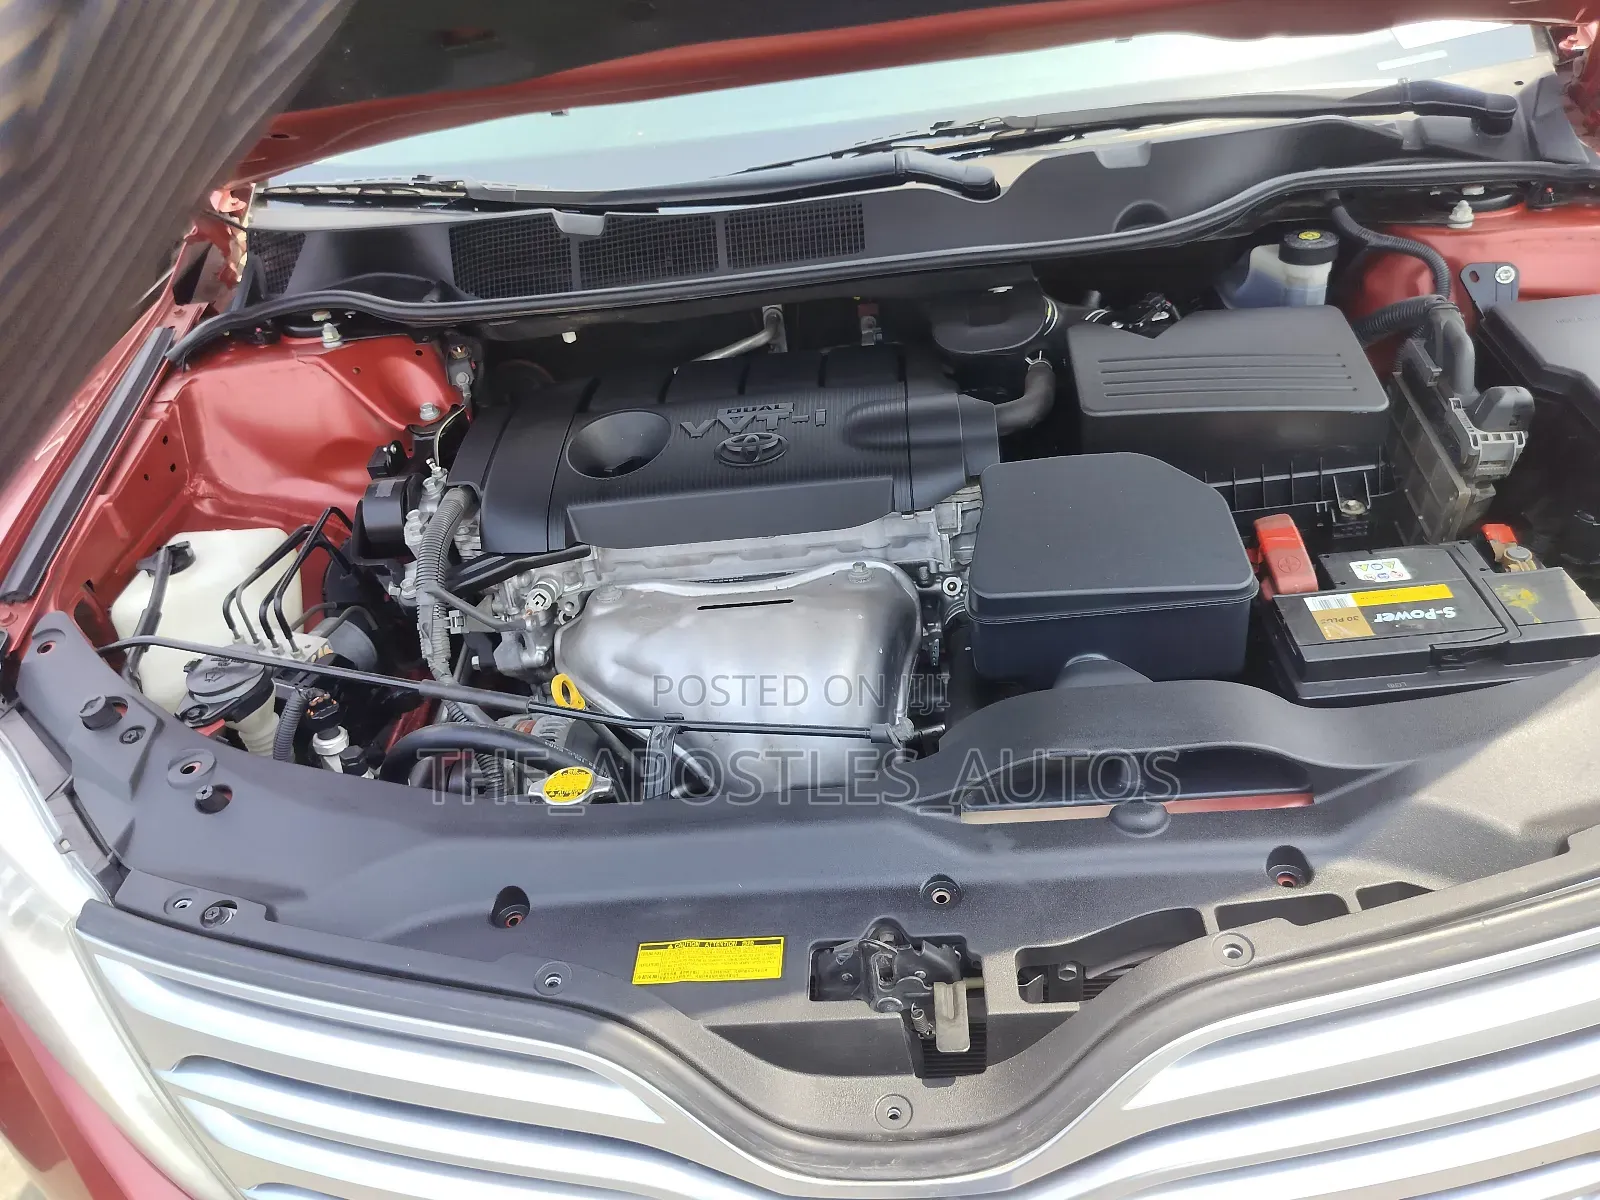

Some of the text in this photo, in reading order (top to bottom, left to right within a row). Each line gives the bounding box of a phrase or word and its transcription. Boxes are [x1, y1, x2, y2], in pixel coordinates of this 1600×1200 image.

[726, 403, 787, 415] DUAL
[1373, 606, 1456, 623] S-Power
[674, 940, 701, 949] CAUTION
[704, 940, 738, 948] ATTENTION
